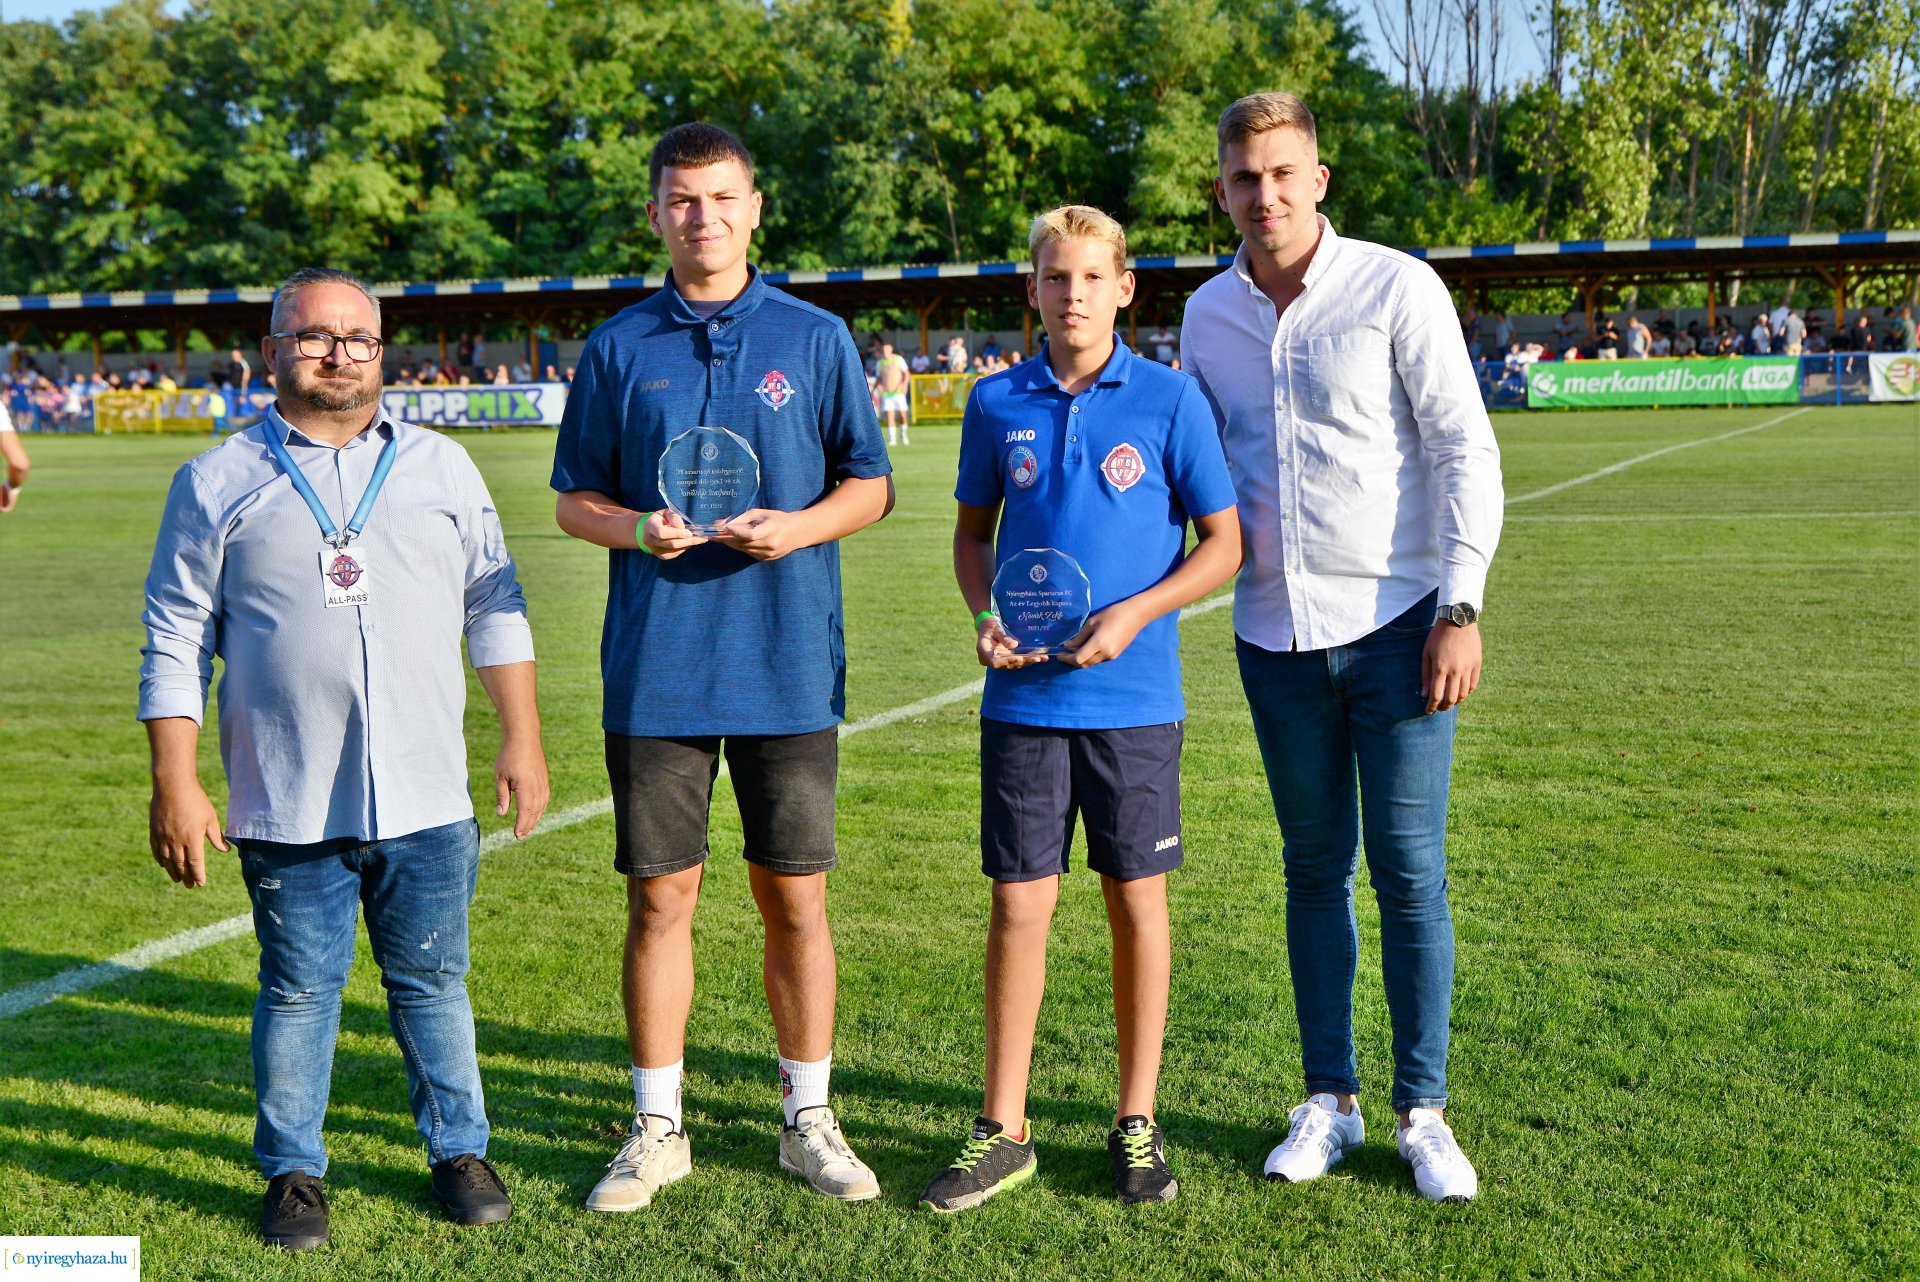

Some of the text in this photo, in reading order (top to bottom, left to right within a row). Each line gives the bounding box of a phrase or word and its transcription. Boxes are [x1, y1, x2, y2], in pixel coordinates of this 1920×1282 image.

[640, 378, 670, 392] JAKO
[1563, 367, 1790, 394] merkantilbank LIGA
[1005, 429, 1036, 443] JAKO
[328, 593, 368, 605] ALL-PASS
[1154, 836, 1179, 852] JAKO
